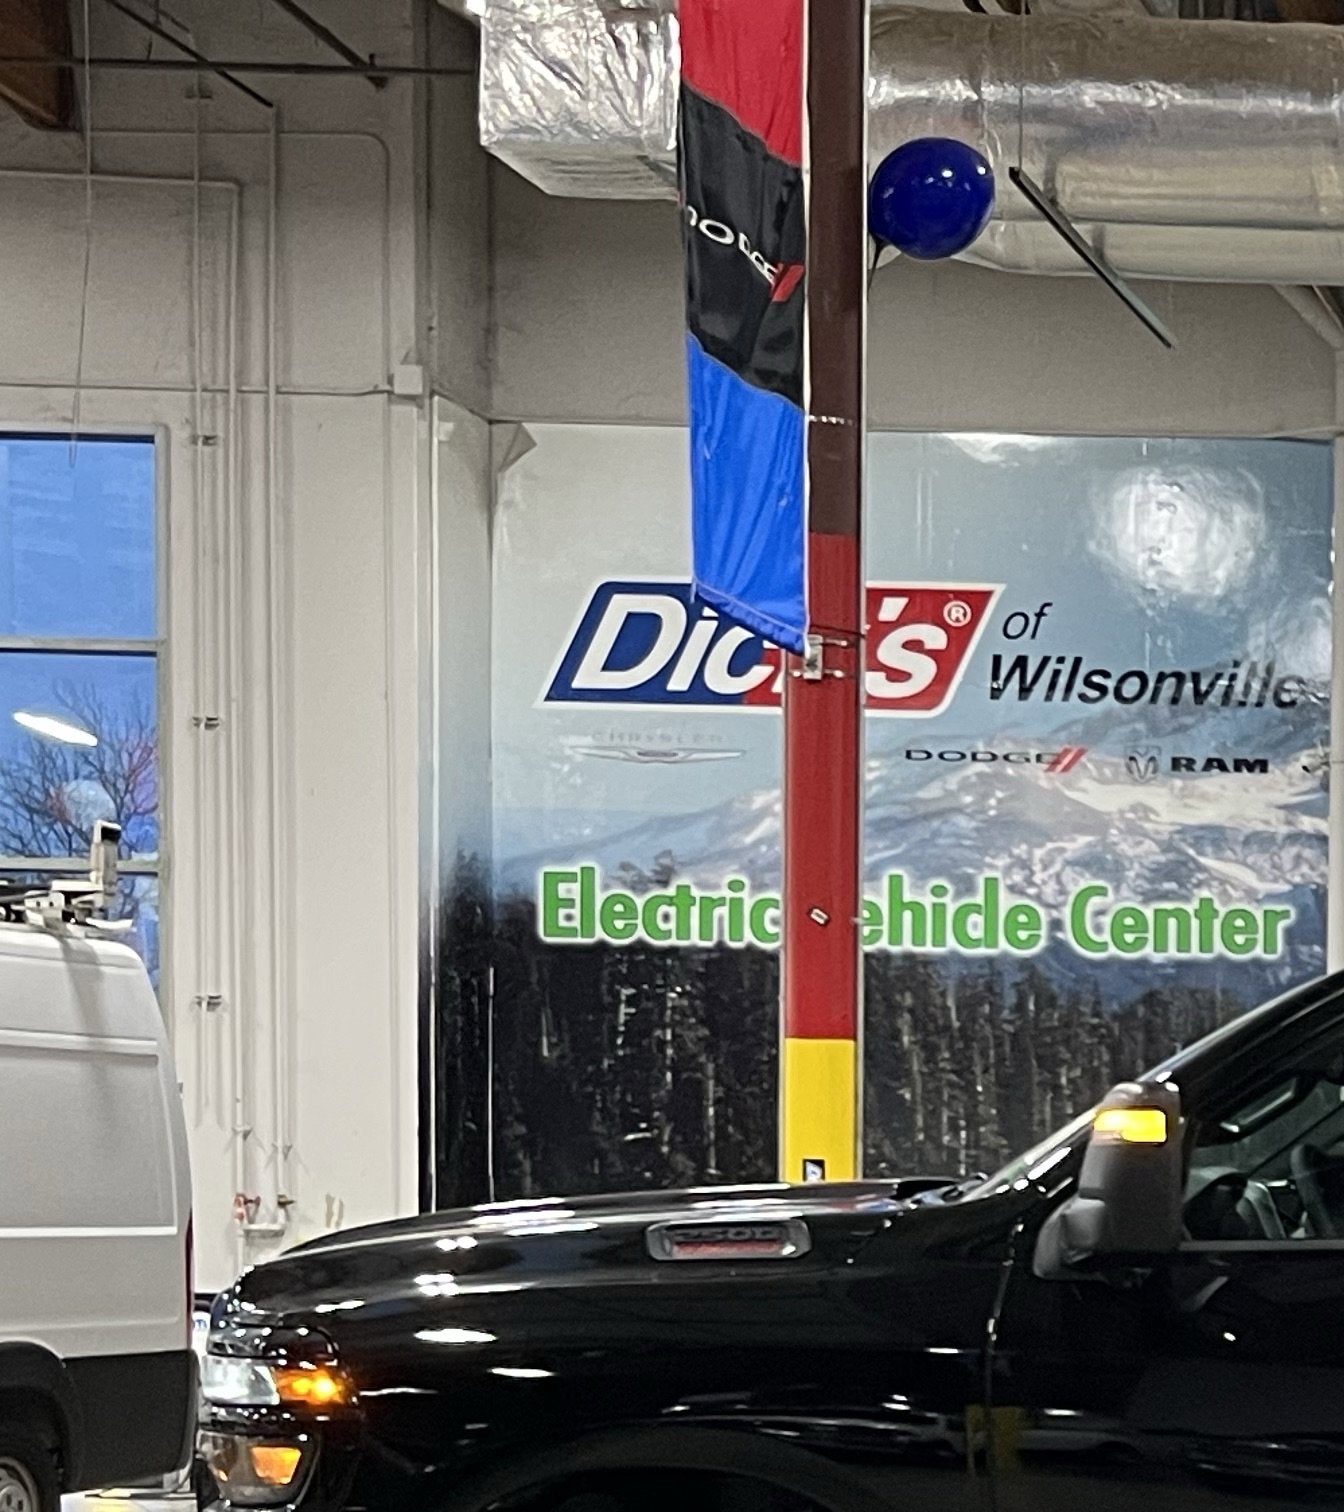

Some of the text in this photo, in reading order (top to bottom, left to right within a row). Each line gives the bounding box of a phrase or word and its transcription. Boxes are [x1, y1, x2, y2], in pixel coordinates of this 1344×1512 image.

[1001, 602, 1053, 641] of
[989, 653, 1302, 708] Wilsonville
[1170, 755, 1270, 774] RAM
[542, 866, 1292, 956] Electric ehicle Center
